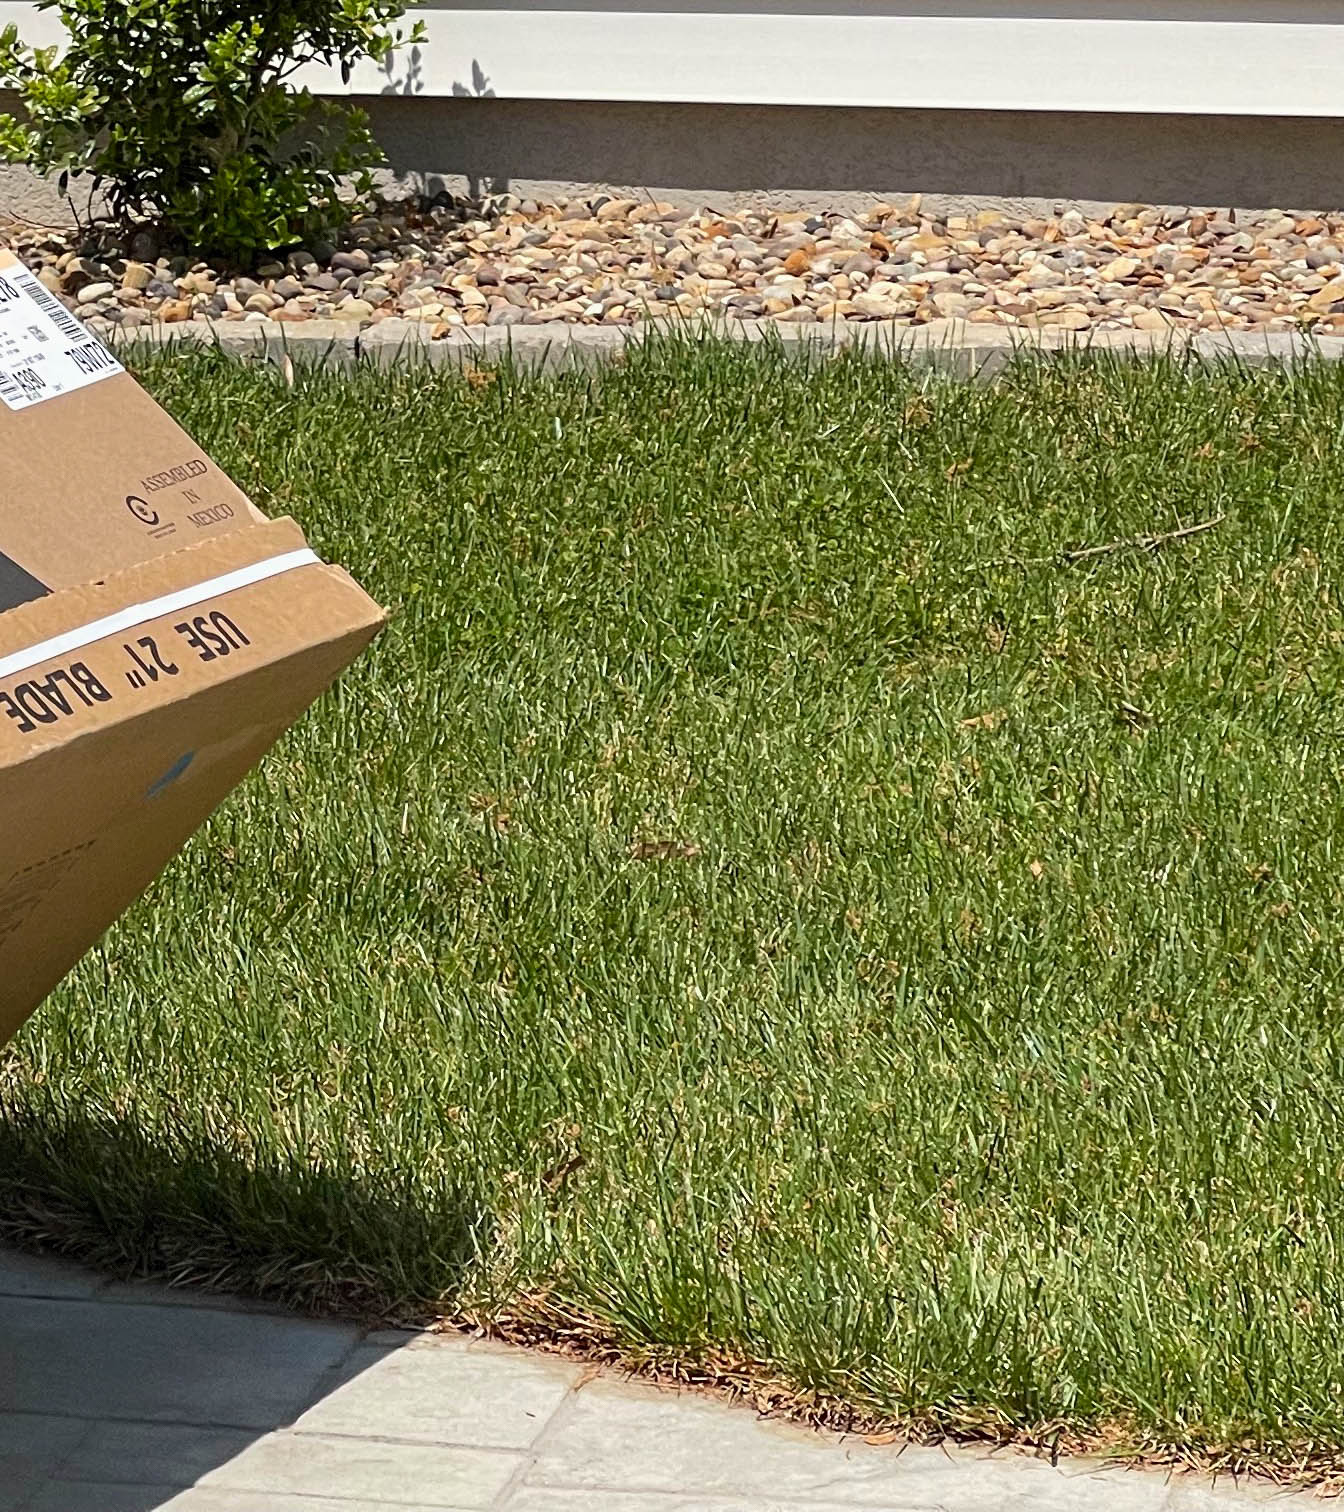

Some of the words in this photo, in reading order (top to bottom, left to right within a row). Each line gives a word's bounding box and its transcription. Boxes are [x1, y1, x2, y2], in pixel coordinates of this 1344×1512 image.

[64, 341, 116, 375] 79W72
[12, 367, 48, 395] A390
[140, 459, 208, 494] ASSEMBLED
[181, 488, 201, 505] IN
[186, 503, 235, 529] MEXICO
[173, 611, 251, 662] USE
[122, 636, 180, 689] 21"
